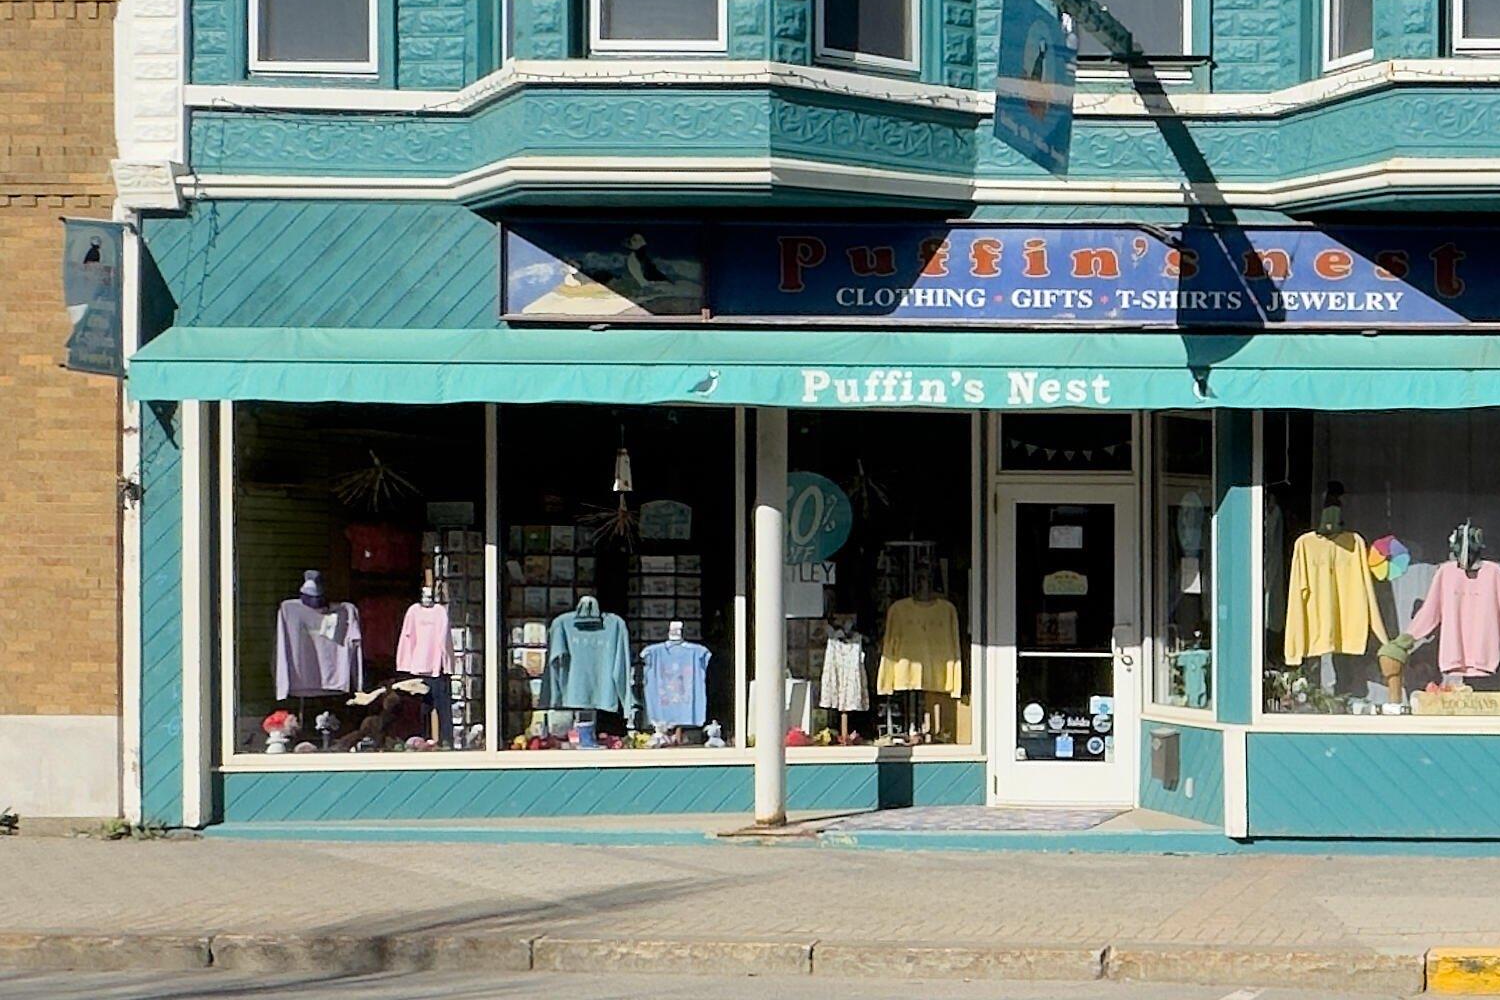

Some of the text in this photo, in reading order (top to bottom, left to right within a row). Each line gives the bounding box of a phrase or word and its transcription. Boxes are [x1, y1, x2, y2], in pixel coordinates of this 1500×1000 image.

[777, 234, 1466, 298] Puffin's nest
[835, 287, 1404, 312] CLOTHING GIFTS T-SHIRTS JEWELRY
[801, 369, 1113, 405] Puffin's Nest
